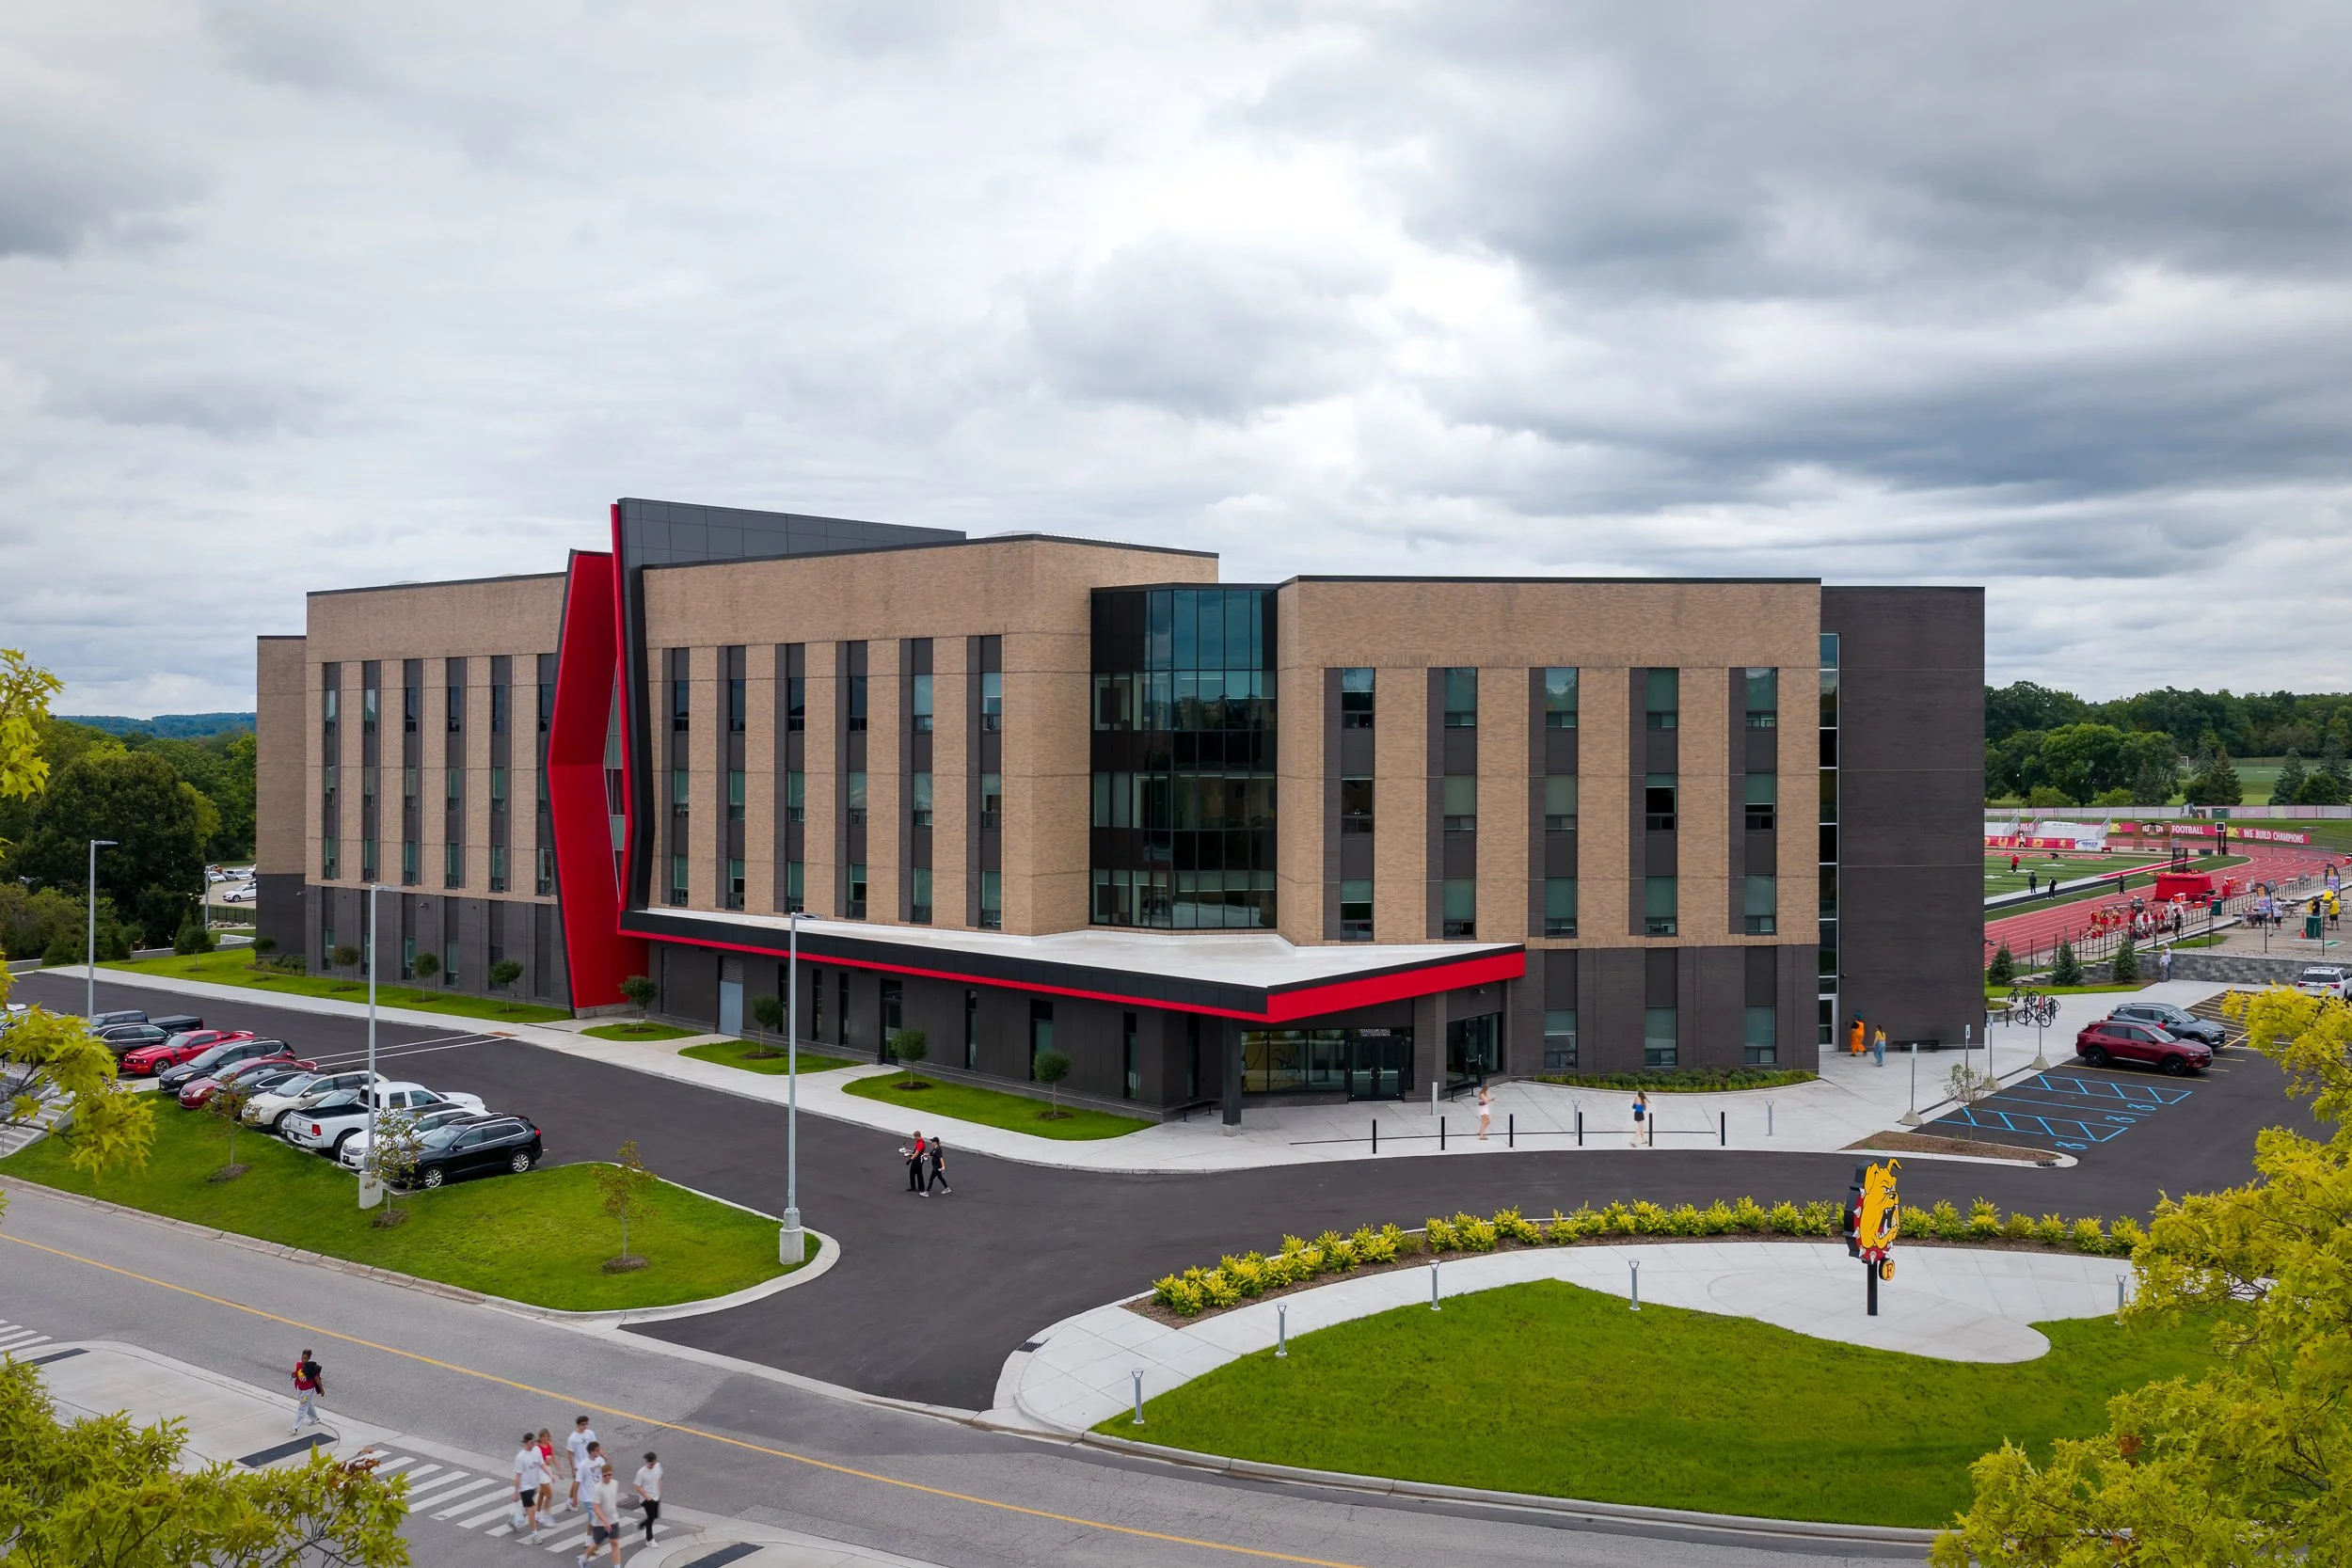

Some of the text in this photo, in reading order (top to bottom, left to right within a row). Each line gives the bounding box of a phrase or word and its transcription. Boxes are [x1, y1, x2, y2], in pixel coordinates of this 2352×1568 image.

[2171, 825, 2204, 834] FOOTBALL
[2243, 829, 2304, 844] WE BUILD CHAMPIONS
[1885, 1262, 1893, 1279] F
